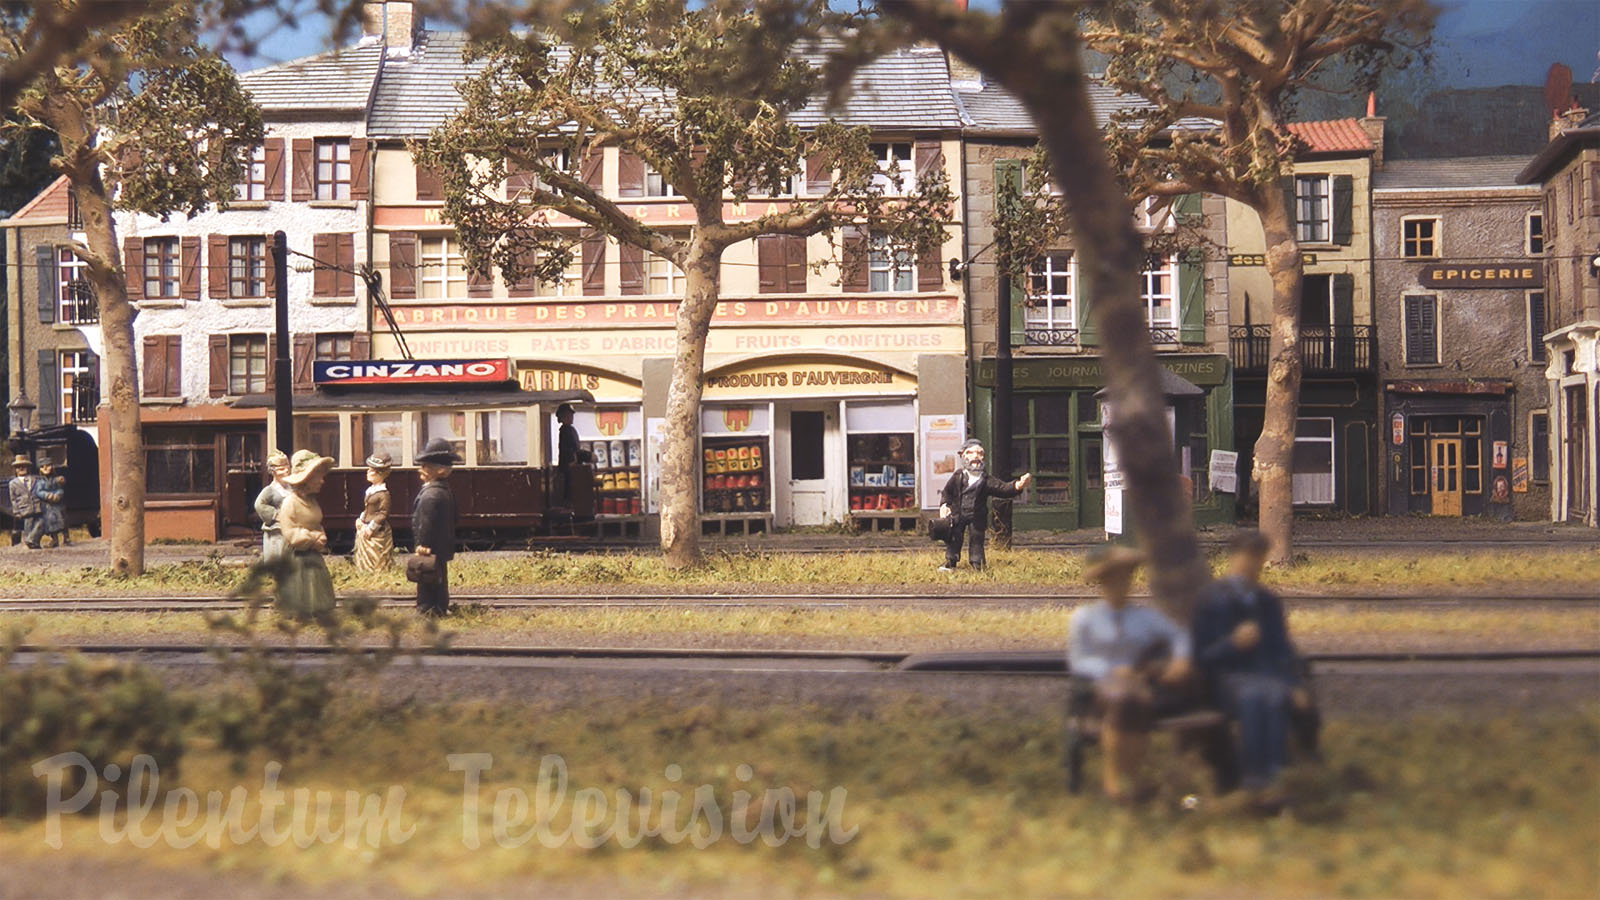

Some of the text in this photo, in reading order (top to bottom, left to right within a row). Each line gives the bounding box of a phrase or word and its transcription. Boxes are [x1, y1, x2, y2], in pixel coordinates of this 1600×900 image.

[1432, 268, 1533, 280] EPICERIE
[375, 300, 948, 323] FABRIQUE DES PRALES D'AUVERGNE
[602, 335, 712, 350] D'ABRICS
[735, 334, 802, 349] FRUITS
[824, 333, 942, 348] CONFITURES
[325, 362, 496, 379] CINZANO
[982, 367, 1030, 379] LIES
[707, 371, 893, 389] PRODUITS D'AUVERGNE
